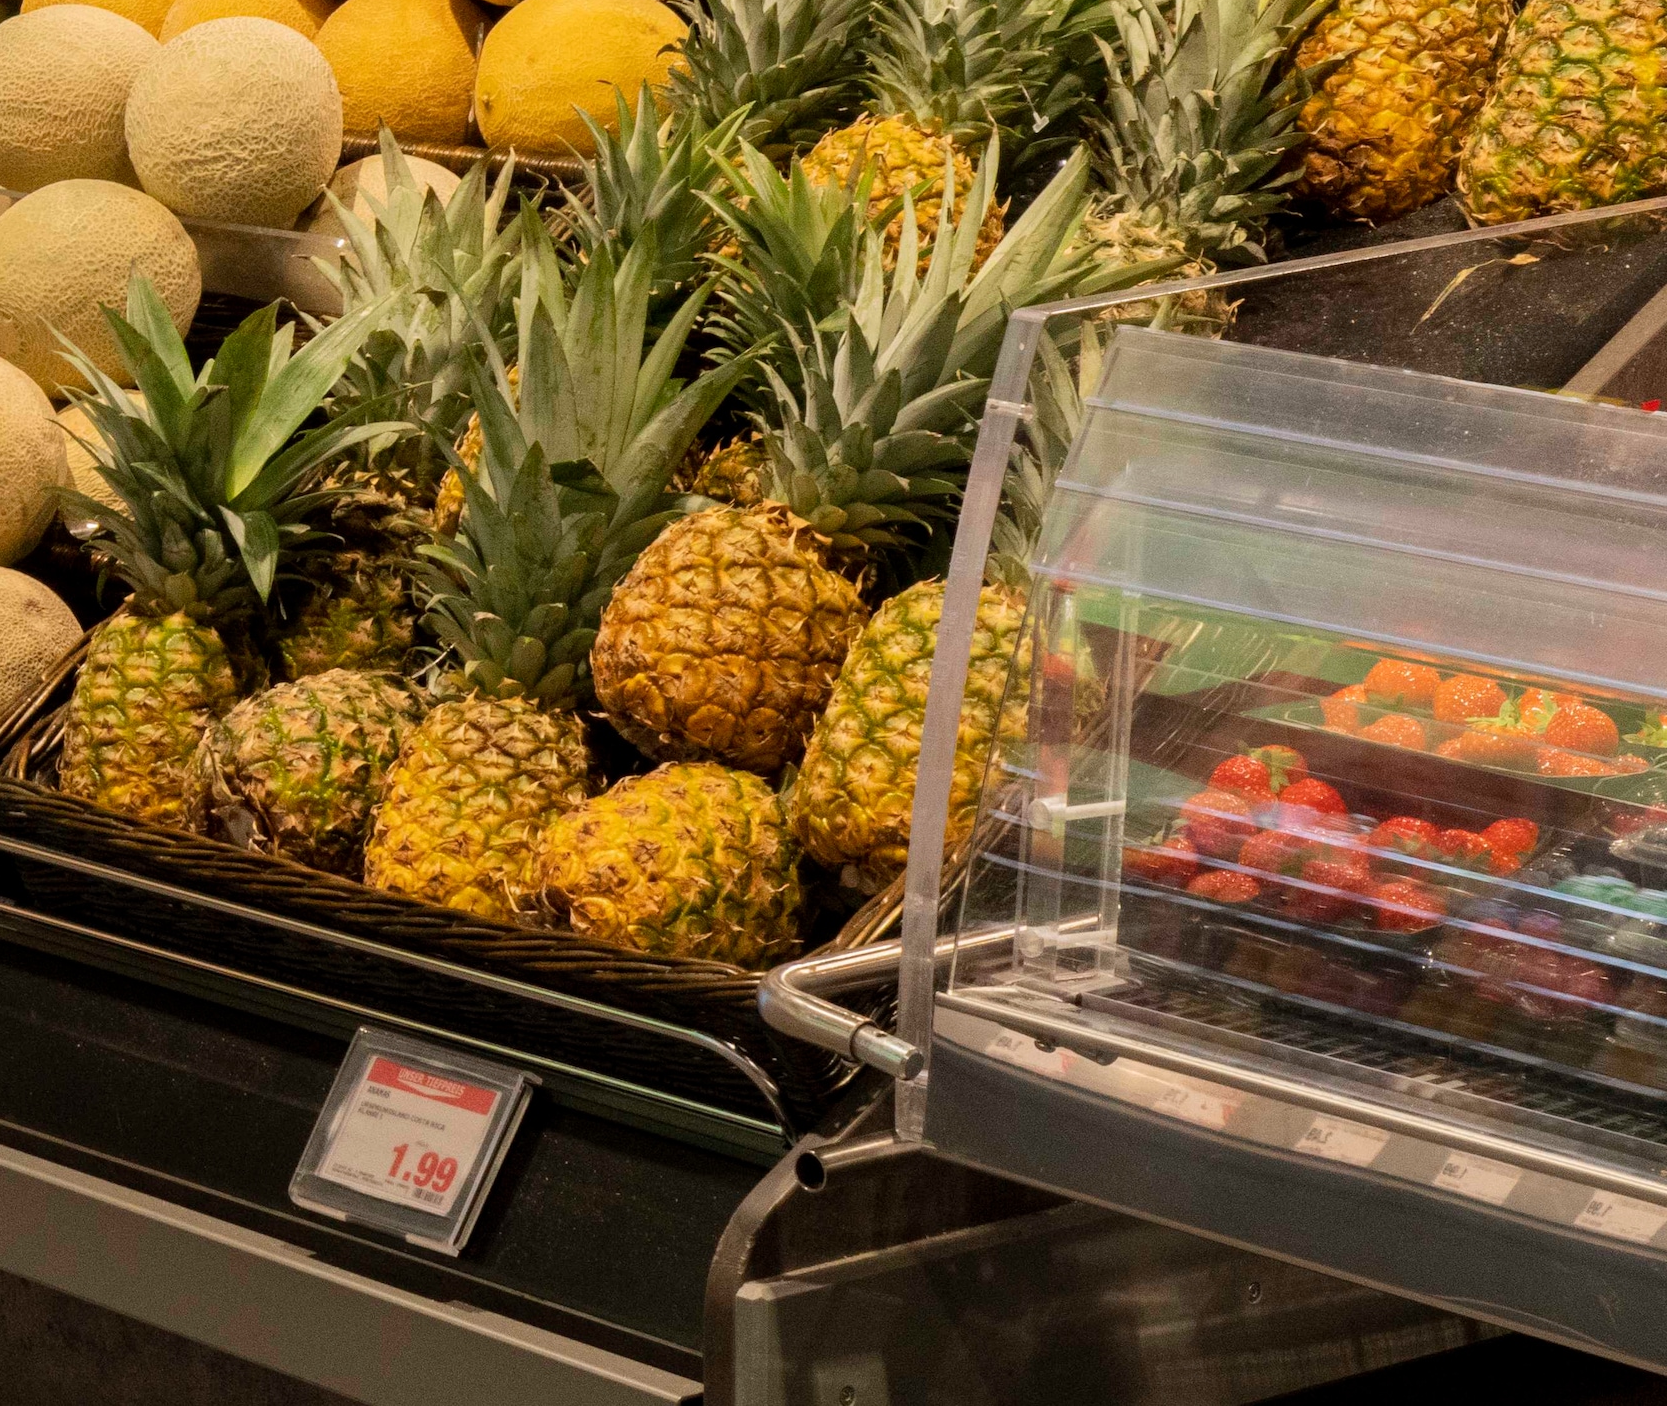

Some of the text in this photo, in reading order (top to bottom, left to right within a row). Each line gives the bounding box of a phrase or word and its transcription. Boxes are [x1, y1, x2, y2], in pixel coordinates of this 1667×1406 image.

[398, 1068, 467, 1097] UNSER TIEFPREIS
[388, 1143, 459, 1193] 1.99
